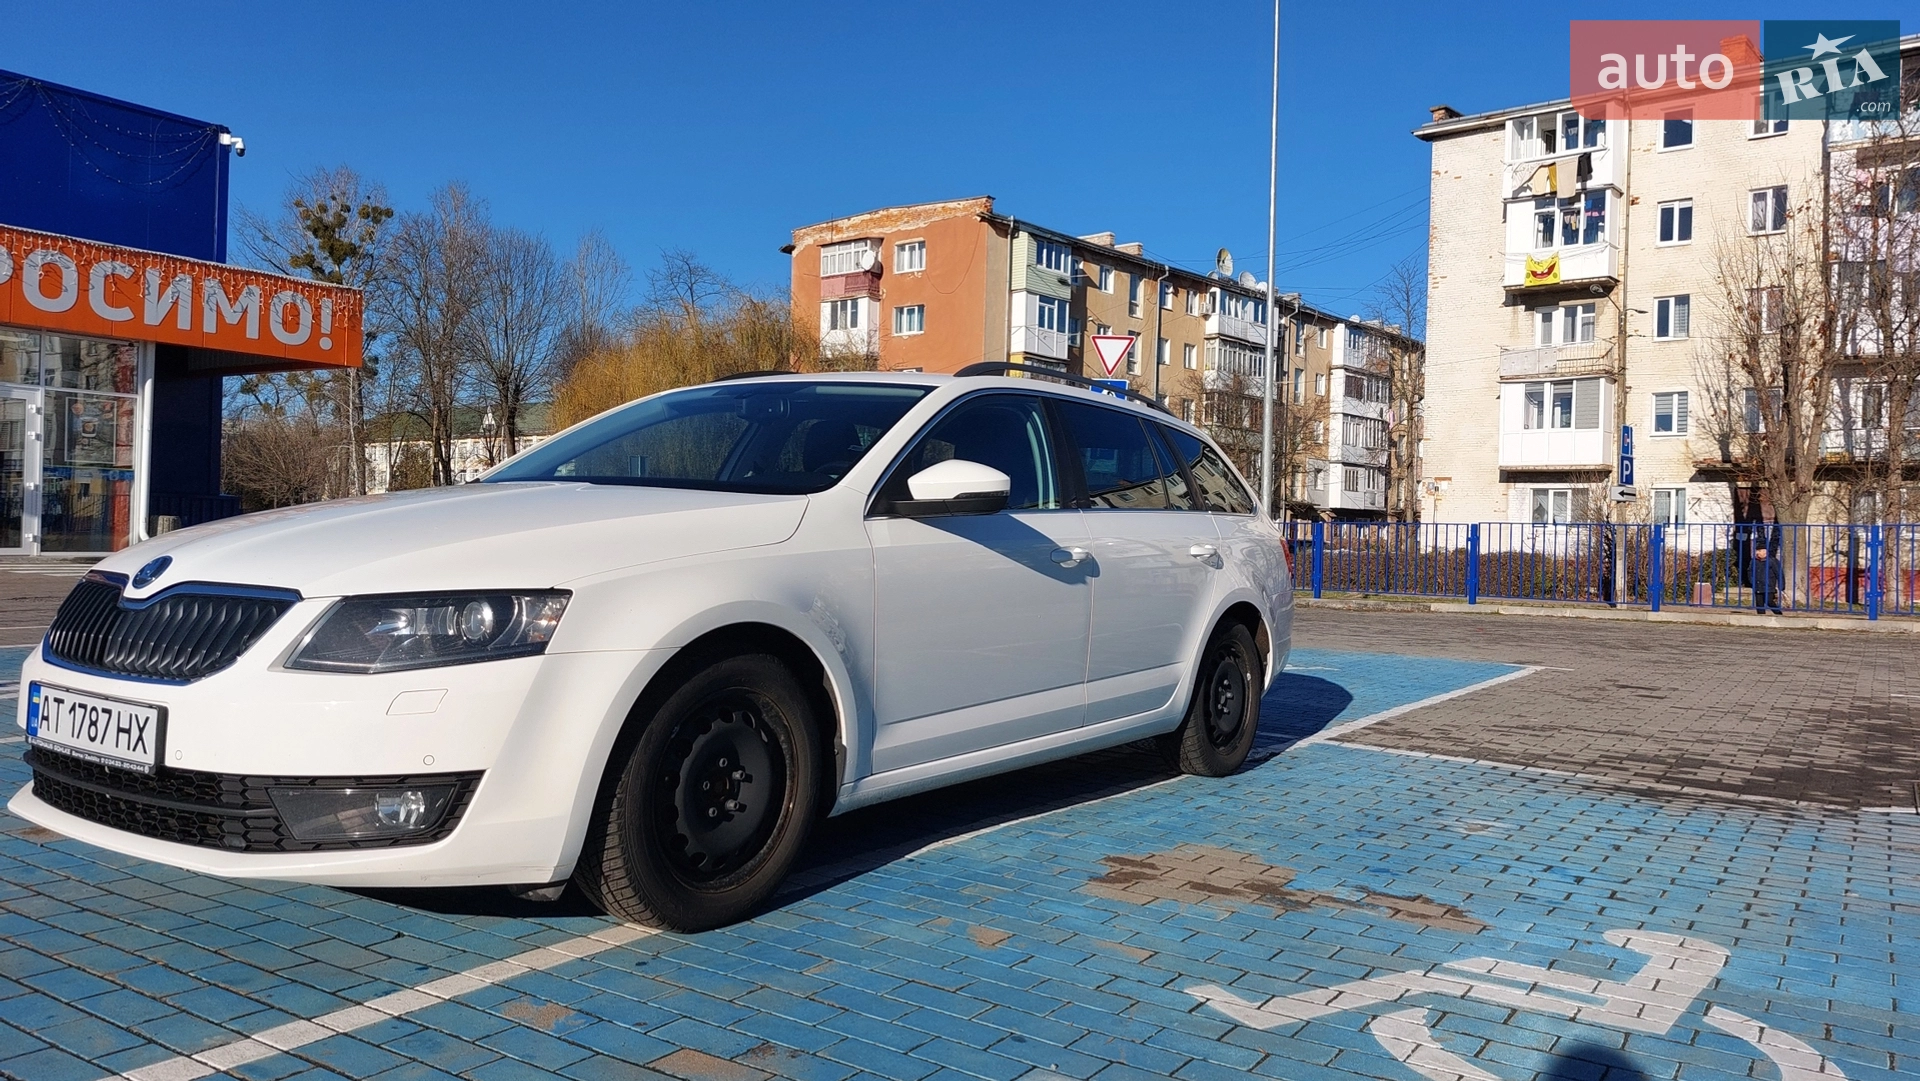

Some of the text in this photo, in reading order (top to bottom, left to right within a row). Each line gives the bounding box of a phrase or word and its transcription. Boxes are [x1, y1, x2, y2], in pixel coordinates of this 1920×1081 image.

[0, 245, 333, 350] ОСИМО!
[1623, 460, 1631, 482] P
[39, 695, 150, 754] AT 1787 HX
